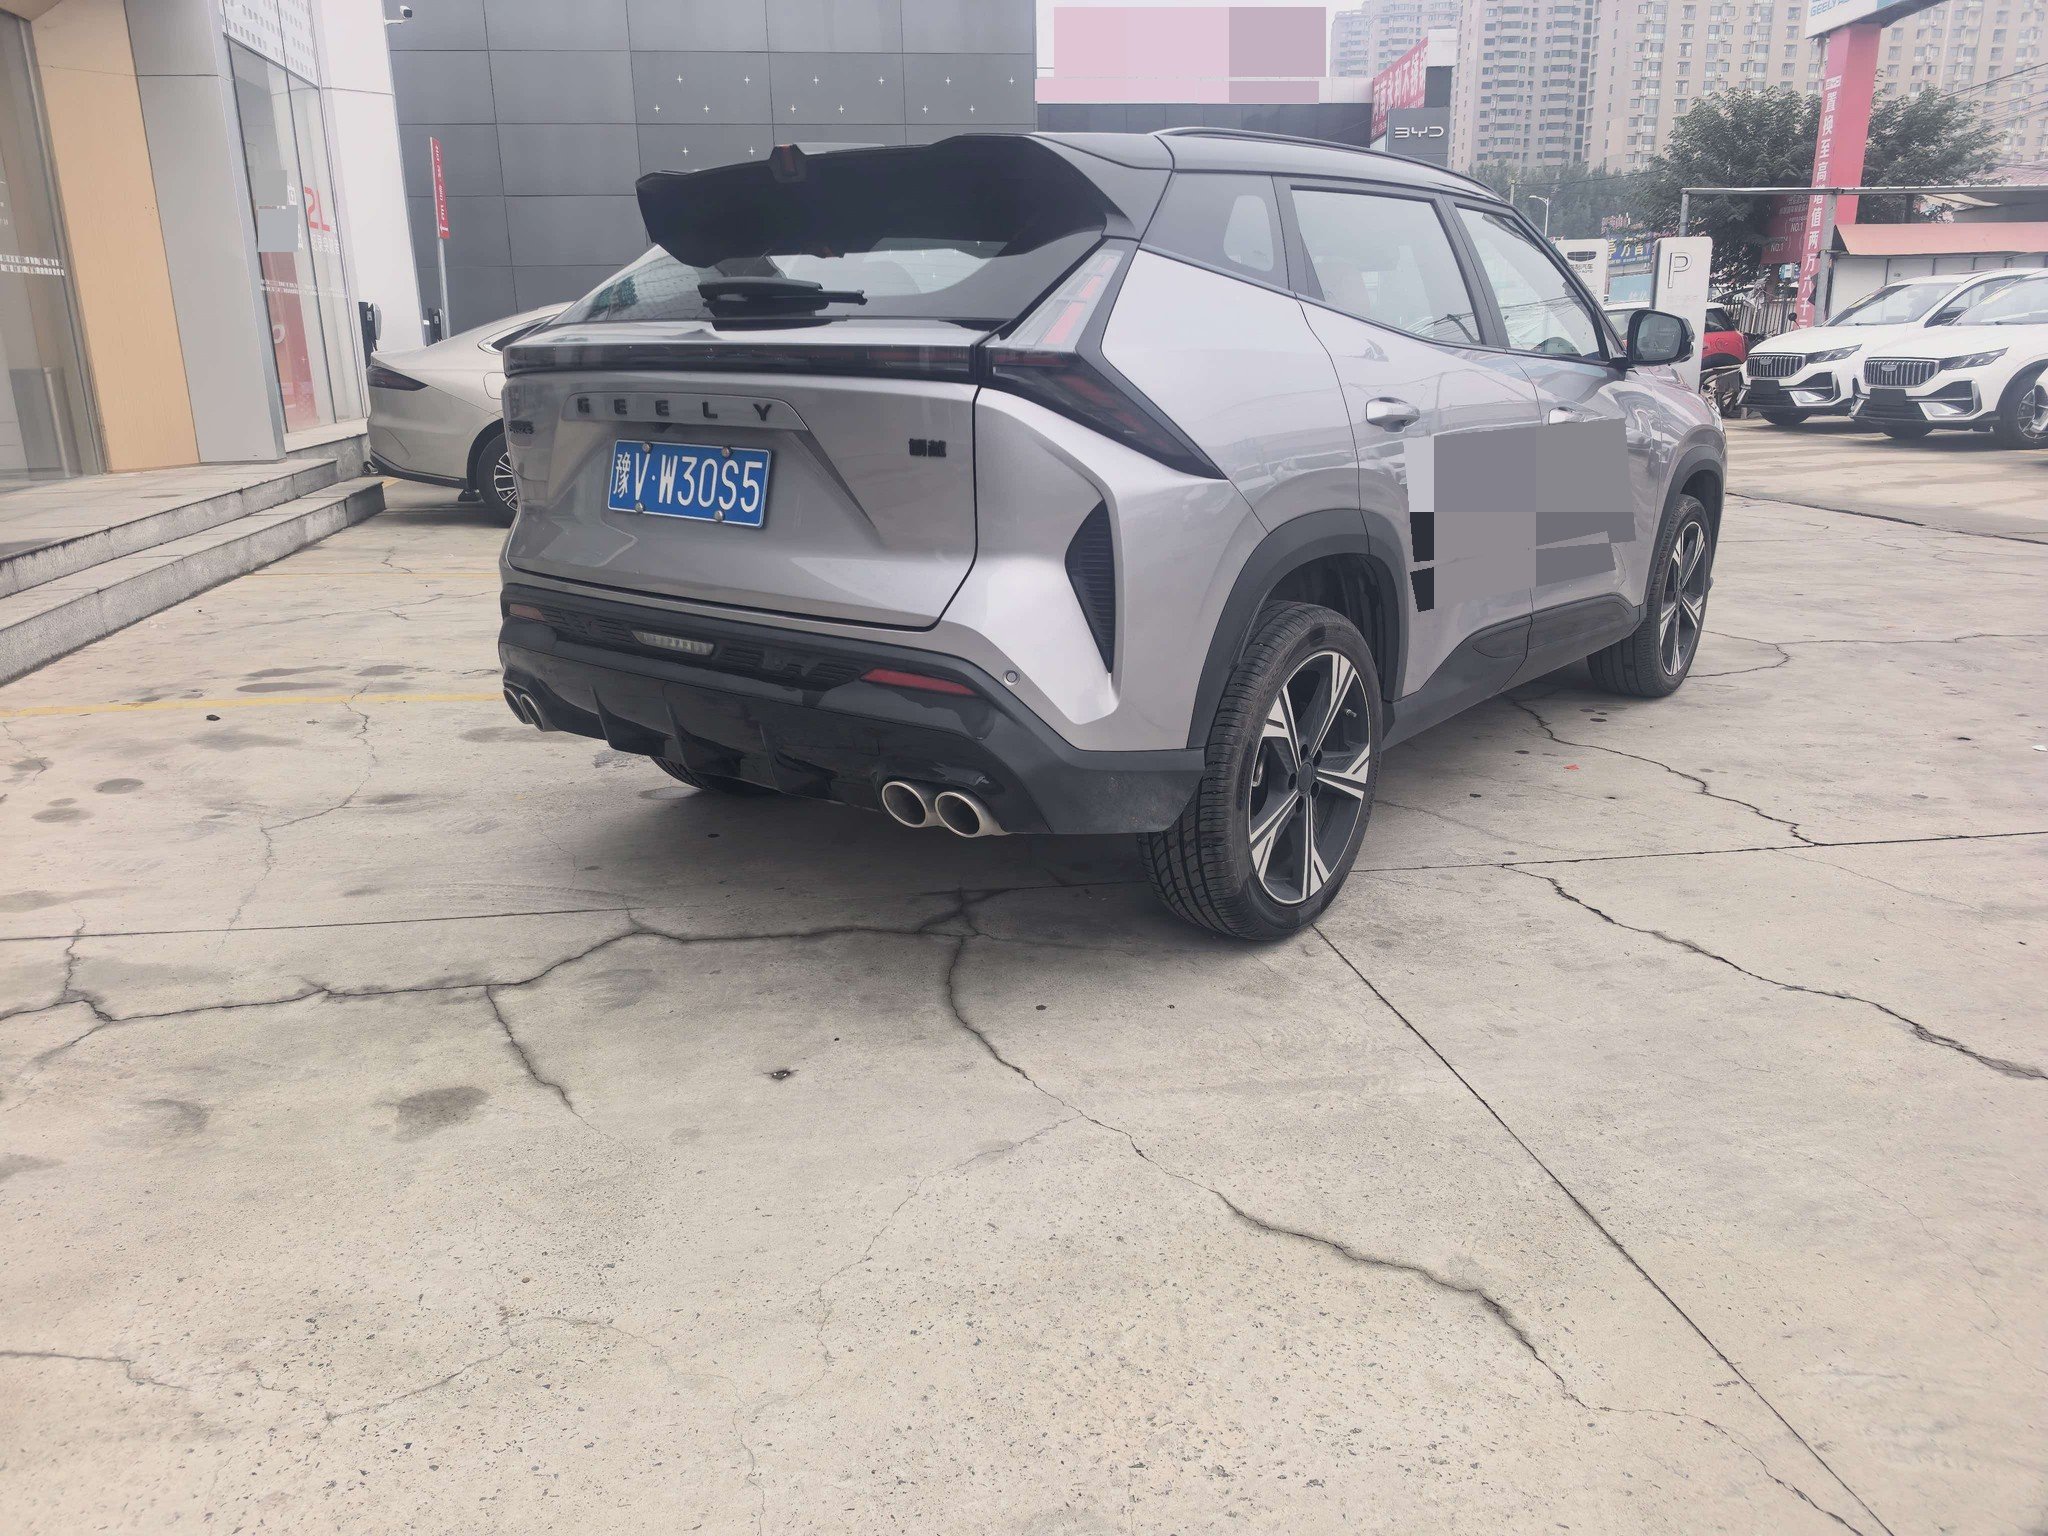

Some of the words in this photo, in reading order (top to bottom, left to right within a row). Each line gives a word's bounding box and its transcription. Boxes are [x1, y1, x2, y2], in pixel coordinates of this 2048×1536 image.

[1394, 125, 1444, 138] BYD
[1668, 251, 1693, 289] P
[577, 397, 772, 422] GEELY
